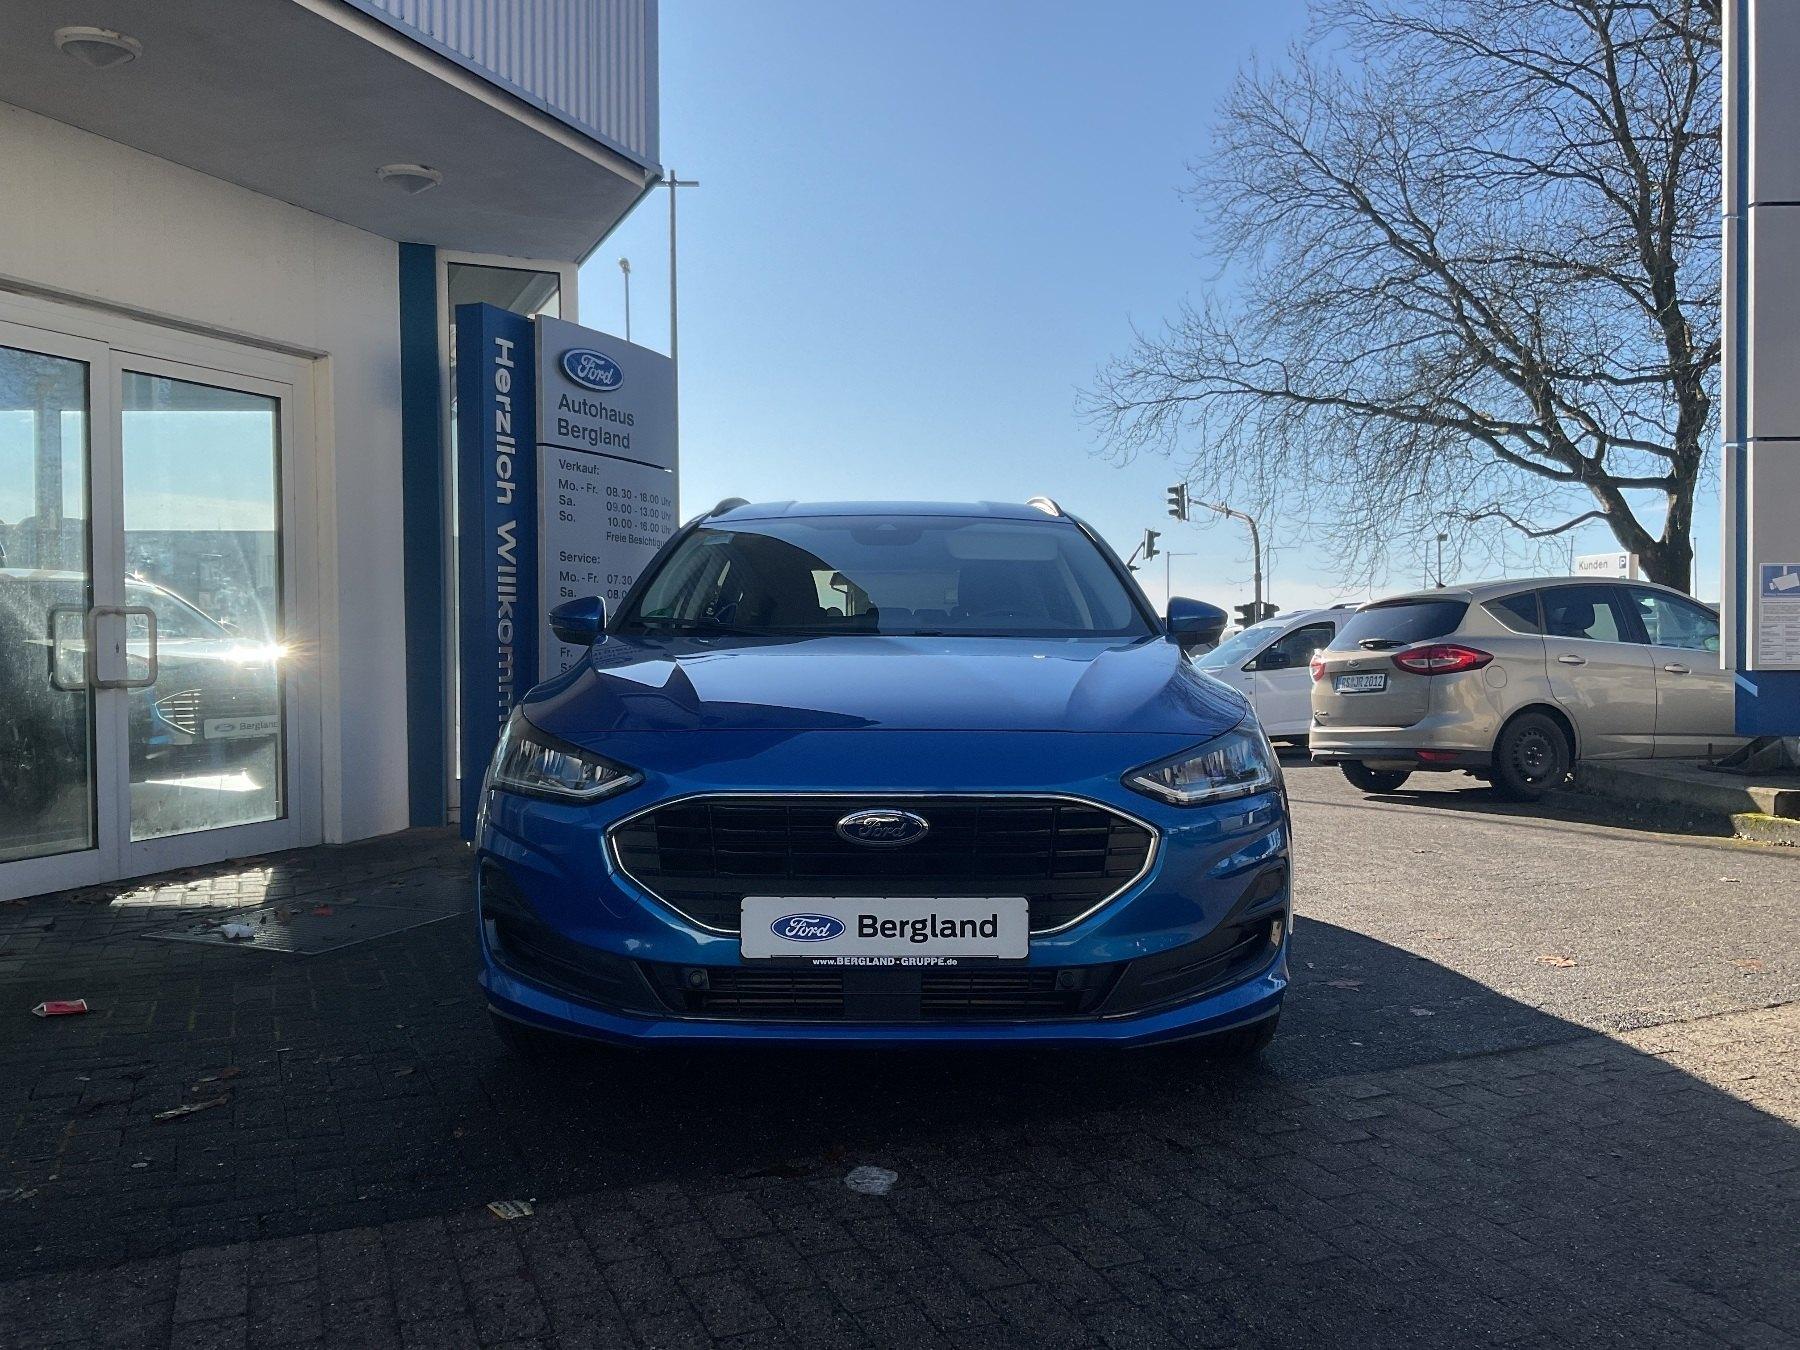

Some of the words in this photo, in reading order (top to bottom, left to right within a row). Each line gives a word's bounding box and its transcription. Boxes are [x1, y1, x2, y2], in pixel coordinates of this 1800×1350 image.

[577, 354, 614, 385] Ford
[558, 393, 635, 427] Autohaus
[495, 337, 516, 505] Herzlich
[557, 417, 631, 450] Bergland
[558, 458, 600, 475] Verkauf:
[558, 478, 579, 492] Mo.
[586, 482, 598, 494] Fr.
[605, 486, 632, 499] 08.30
[558, 494, 576, 507] Sa.
[605, 501, 632, 514] 09.00
[559, 510, 576, 523] So.
[607, 517, 632, 529] 10.00
[606, 531, 627, 543] Freie
[628, 534, 666, 550] Besichtigu
[559, 551, 601, 564] Service:
[1578, 559, 1608, 571] Kunden
[559, 571, 579, 583] Mo.
[587, 573, 599, 584] Fr.
[607, 574, 633, 586] 07.30
[560, 587, 577, 598] Sa.
[497, 520, 517, 737] Willkomm
[560, 647, 573, 658] Fr.
[1364, 675, 1383, 687] 2012
[858, 817, 907, 838] Ford
[784, 917, 830, 938] Ford
[857, 914, 998, 944] Bergland
[812, 957, 958, 966] www.BERGLAND-GRUPPE.de
